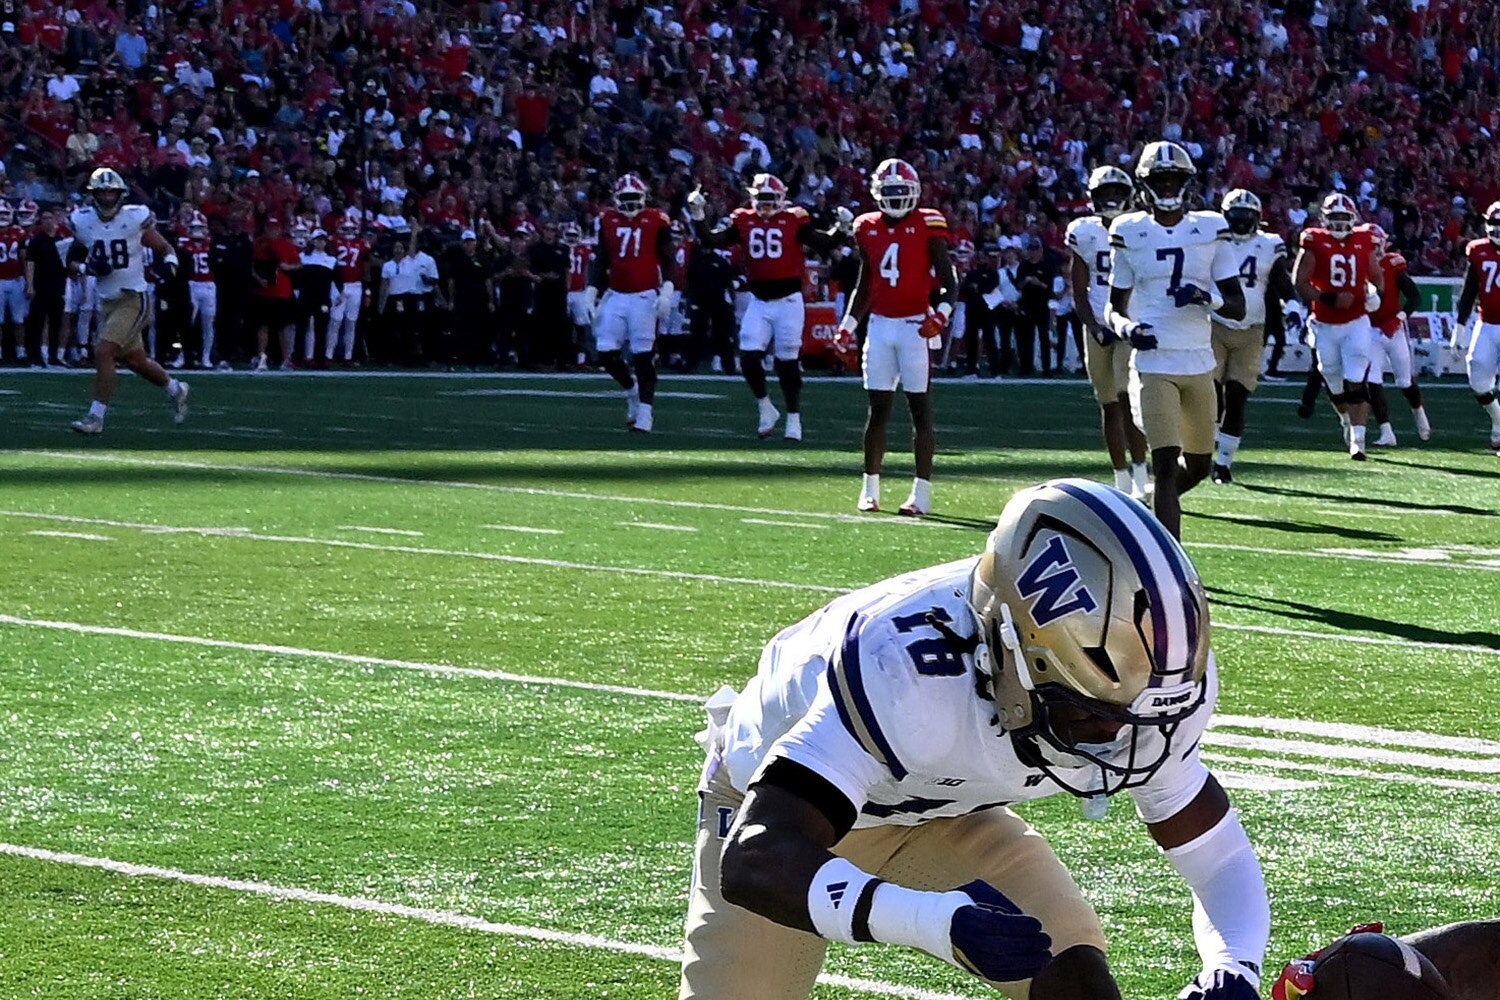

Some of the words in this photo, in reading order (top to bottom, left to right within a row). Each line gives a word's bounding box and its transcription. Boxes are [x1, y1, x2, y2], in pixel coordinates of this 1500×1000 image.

[92, 238, 129, 270] 48
[336, 245, 360, 268] 27
[616, 226, 642, 258] 71
[749, 227, 783, 259] 66
[192, 252, 209, 275] 15
[879, 242, 900, 288] 4
[1156, 247, 1185, 297] 7
[1329, 253, 1357, 287] 61
[1015, 534, 1099, 629] W
[891, 606, 968, 677] 18
